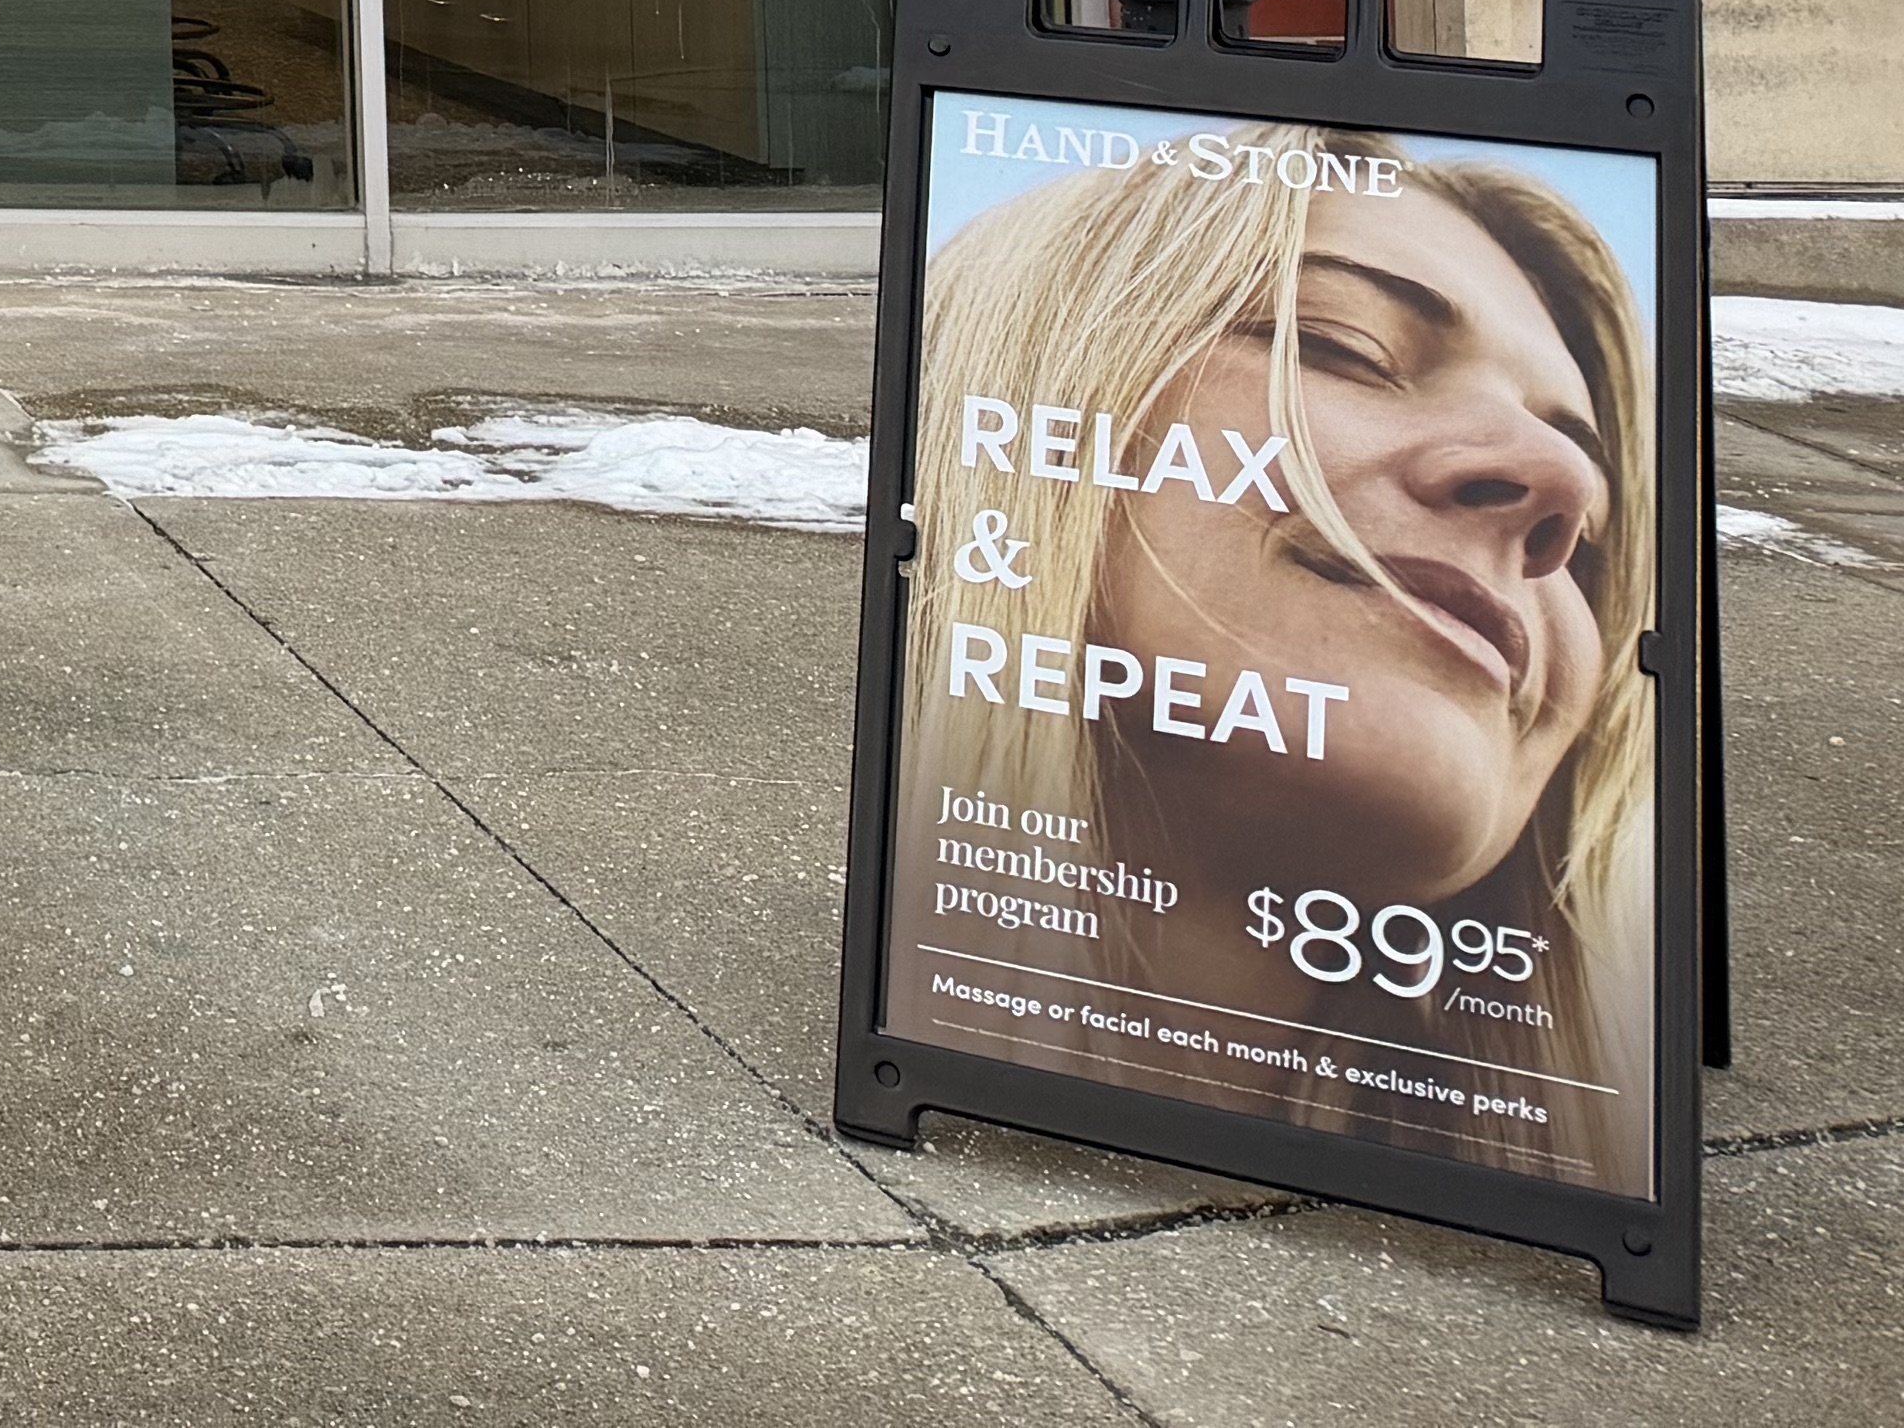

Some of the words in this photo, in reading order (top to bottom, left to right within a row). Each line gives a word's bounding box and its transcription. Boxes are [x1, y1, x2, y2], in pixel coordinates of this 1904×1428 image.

[960, 110, 1140, 170] HAND
[1151, 140, 1180, 167] &
[1188, 133, 1405, 198] STONE
[960, 394, 1290, 514] RELAX
[953, 508, 1034, 590] &
[948, 621, 1350, 761] REPEAT
[936, 785, 1012, 830] Join
[1020, 808, 1089, 844] our
[934, 881, 1100, 940] program
[936, 837, 1179, 914] membership
[932, 973, 1042, 1017] Massage
[1048, 1002, 1075, 1023] or
[1080, 1004, 1150, 1039] facial
[1156, 1024, 1219, 1054] each
[1226, 1039, 1309, 1074] month
[1314, 1056, 1339, 1080] &
[1344, 1066, 1466, 1107] exclusive
[1472, 1093, 1549, 1125] perks
[1443, 986, 1554, 1030] /month
